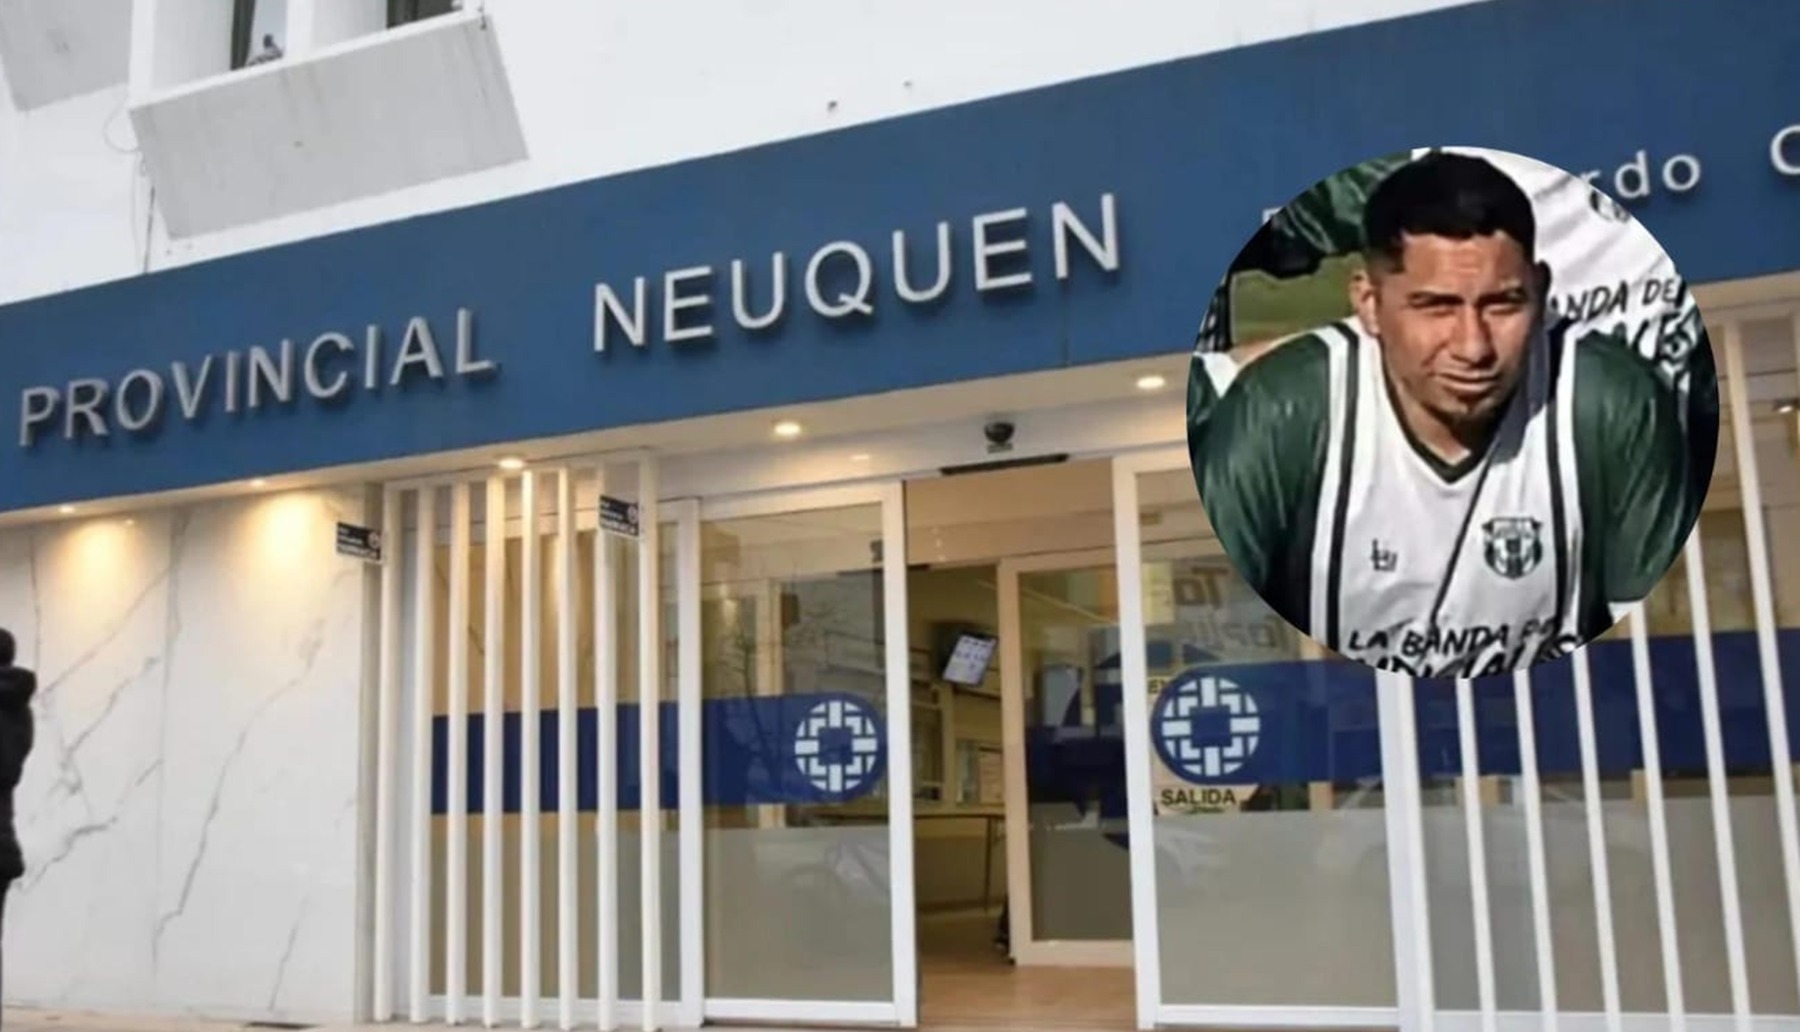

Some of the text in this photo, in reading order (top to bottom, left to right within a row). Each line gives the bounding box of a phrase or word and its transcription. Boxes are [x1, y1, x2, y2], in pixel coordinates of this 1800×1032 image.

[18, 308, 497, 447] PROVINCIAL
[593, 193, 1120, 352] NEUQUEN
[1348, 630, 1389, 651] LA
[1401, 622, 1509, 657] BANDA
[1160, 787, 1237, 807] SALIDA
